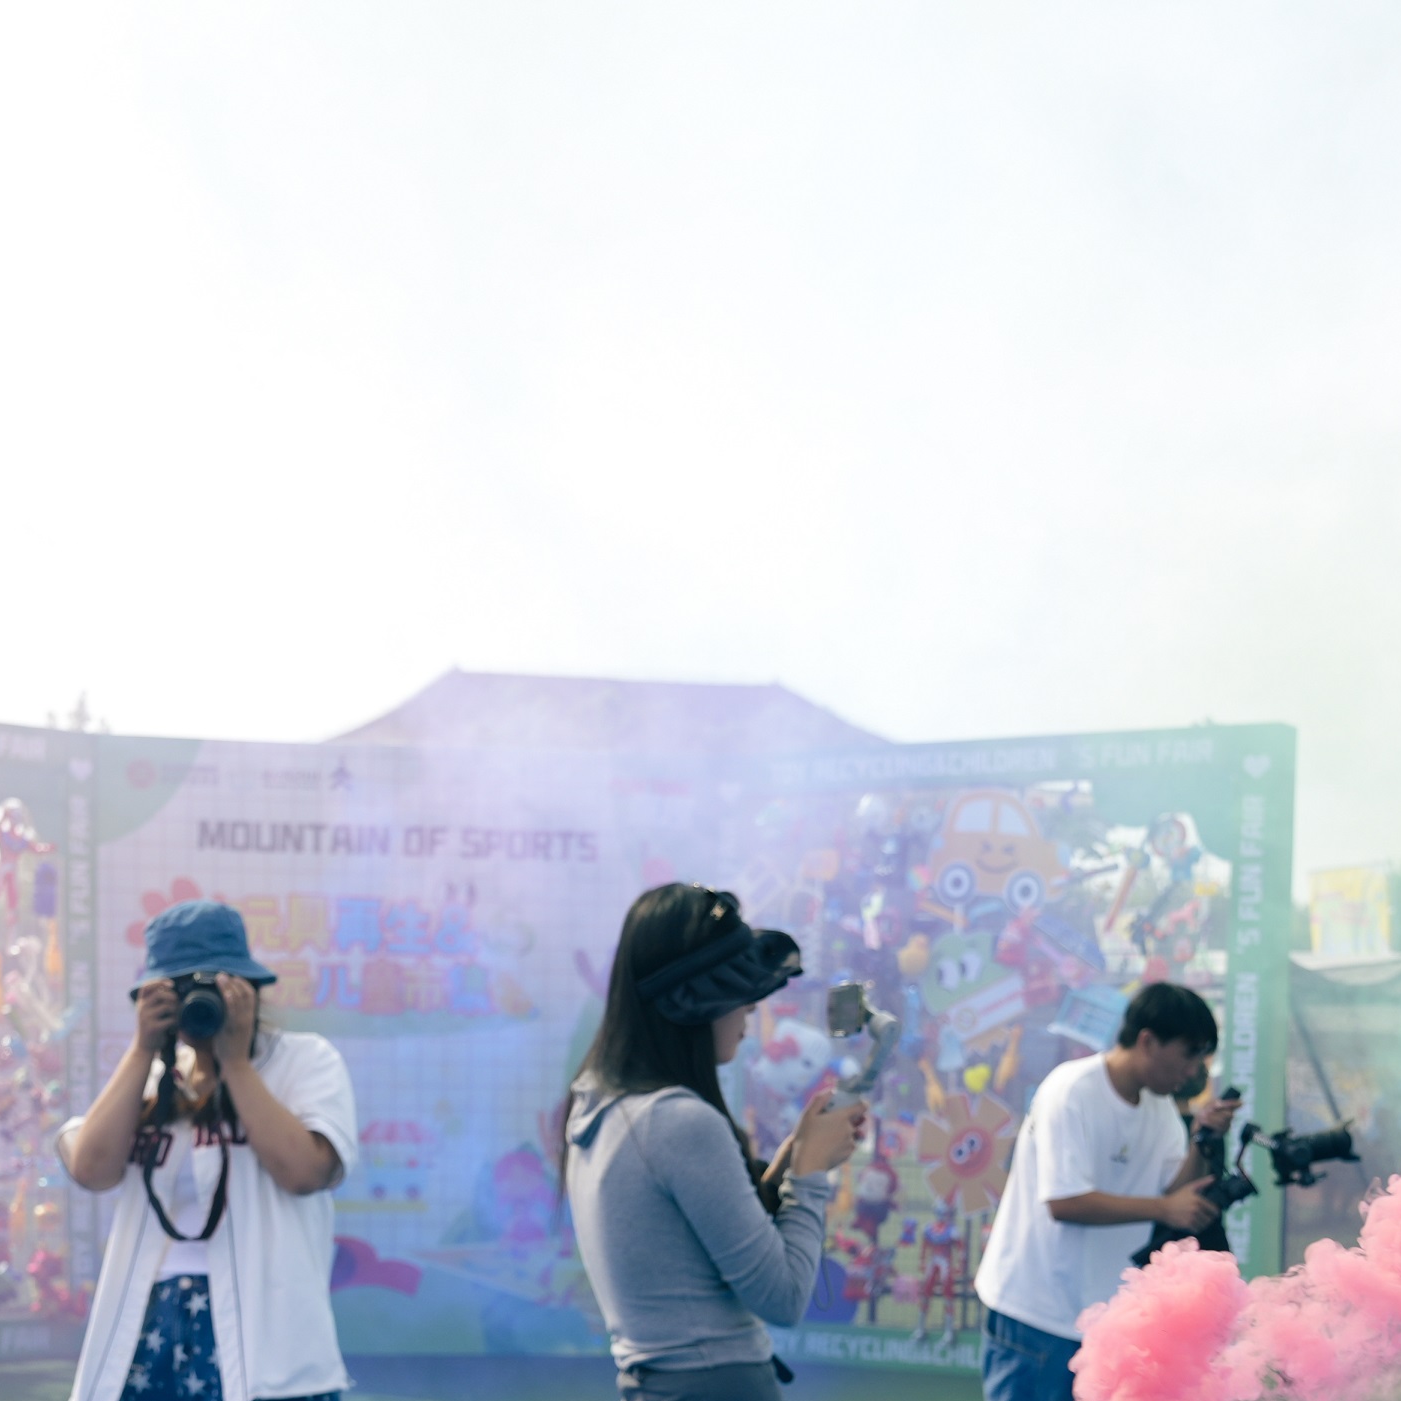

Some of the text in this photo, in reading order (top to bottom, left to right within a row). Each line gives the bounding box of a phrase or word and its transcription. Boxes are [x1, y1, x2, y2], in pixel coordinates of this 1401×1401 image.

[198, 820, 598, 863] MOUNTAIN OF SPORTS
[1240, 793, 1265, 857] FAIR
[1238, 864, 1263, 920] FUN
[0, 1327, 51, 1352] FAIR
